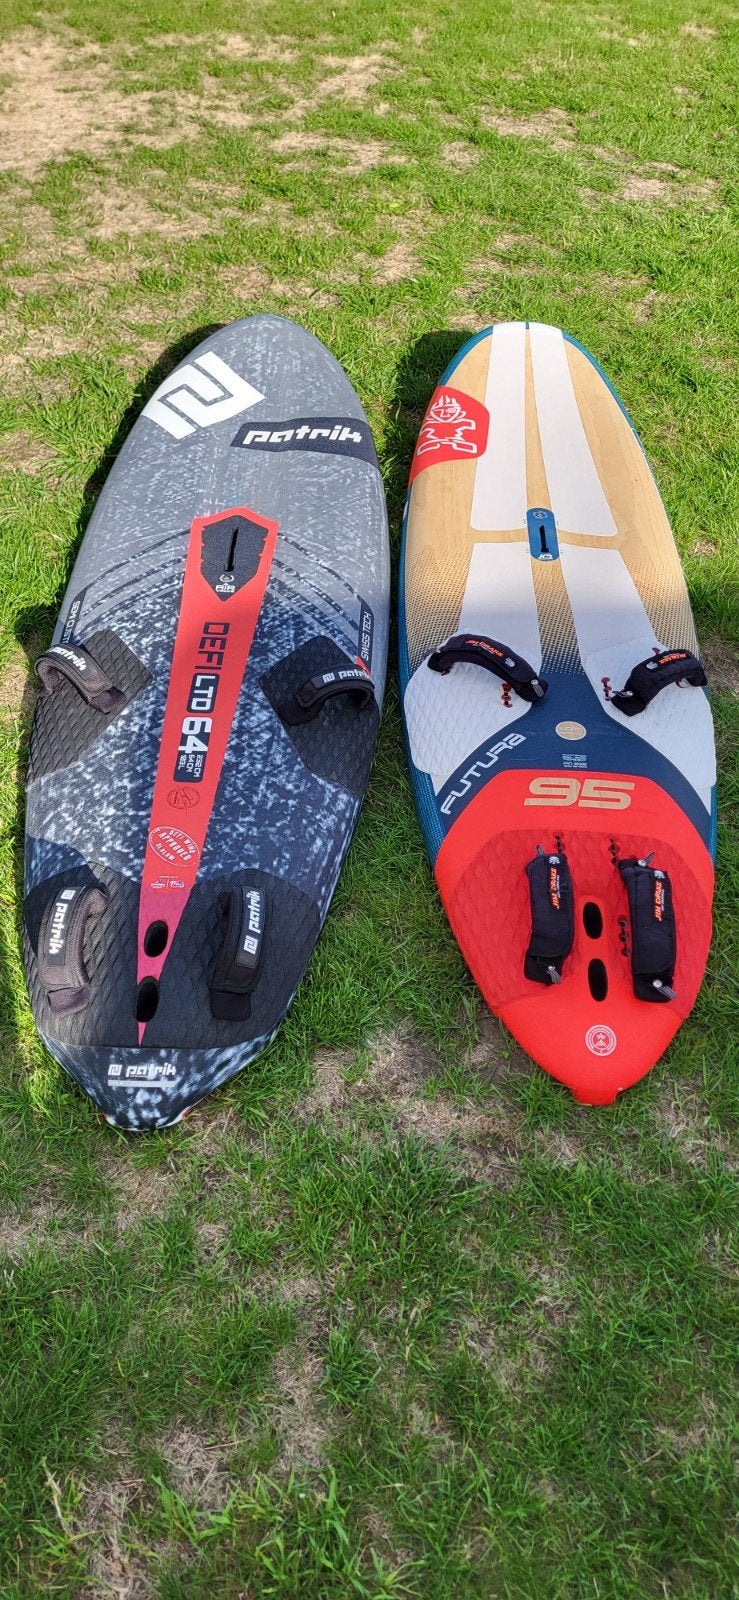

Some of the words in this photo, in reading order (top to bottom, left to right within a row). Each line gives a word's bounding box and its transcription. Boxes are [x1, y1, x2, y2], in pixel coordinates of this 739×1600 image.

[242, 425, 363, 445] patrik
[363, 611, 372, 633] TECH
[195, 622, 230, 670] DEFI
[361, 633, 371, 661] SWISS
[479, 641, 505, 657] DRAKE
[191, 675, 216, 711] LTD
[178, 716, 213, 754] 64
[440, 733, 527, 815] FUTURA
[524, 777, 635, 810] 95
[158, 832, 192, 861] APPROVED
[246, 890, 261, 934] patrik
[551, 892, 560, 910] JIM
[654, 905, 662, 922] JIM
[49, 902, 68, 955] patrik
[125, 1062, 177, 1078] patrik
